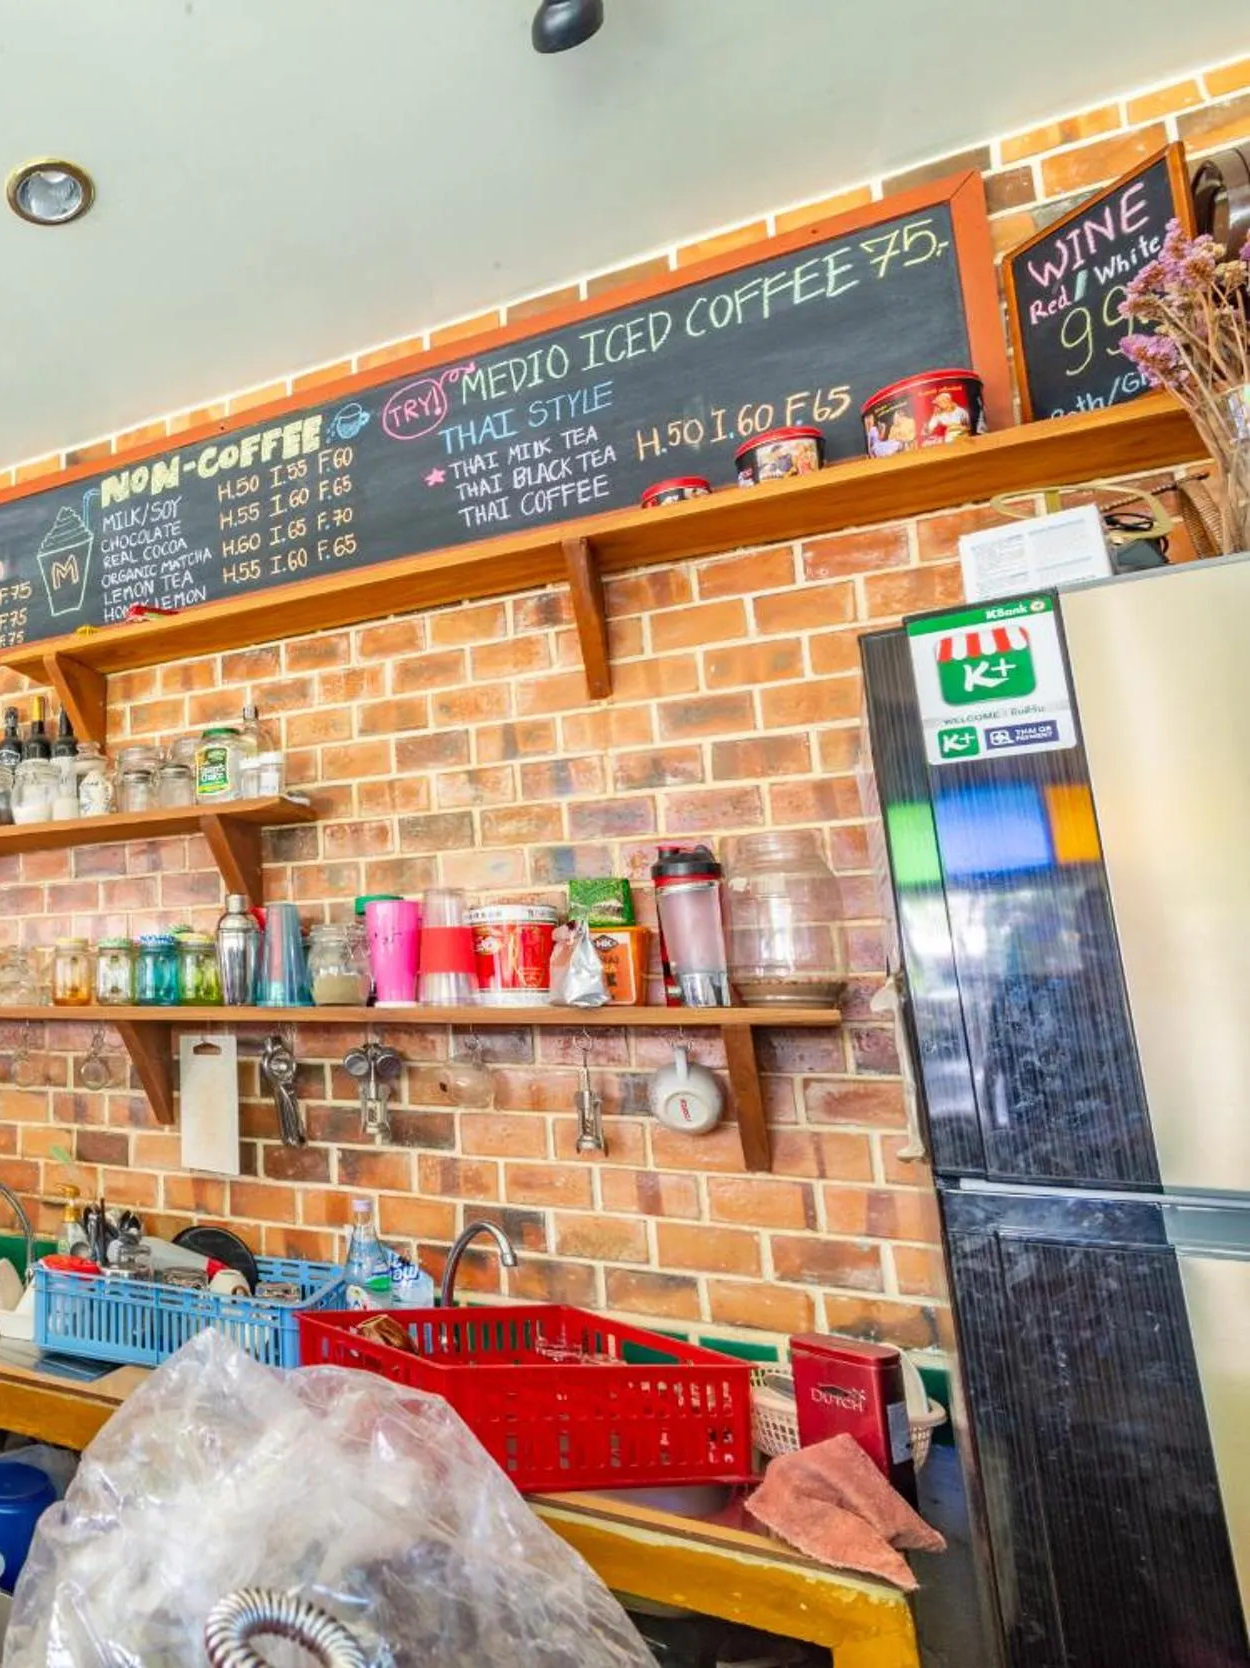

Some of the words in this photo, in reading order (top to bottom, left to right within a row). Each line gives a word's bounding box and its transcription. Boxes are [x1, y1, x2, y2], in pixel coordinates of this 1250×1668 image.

[1027, 181, 1150, 288] WINE
[462, 344, 569, 405] MEDIO
[579, 311, 672, 372] ICED
[686, 247, 860, 337] COFFEE
[389, 386, 442, 428] TRY!
[438, 408, 519, 454] THAI
[528, 380, 614, 428] STYLE
[448, 451, 500, 480] THAI
[507, 437, 553, 465] MILK
[560, 425, 599, 450] TEA
[455, 472, 503, 500] THAI
[513, 456, 573, 489] BLACK
[575, 445, 617, 472] TEA
[103, 496, 183, 532] MILK/SOY
[458, 496, 511, 528] THAI
[521, 474, 610, 516] COFFEE
[101, 520, 182, 553] CHOCOLATE
[103, 550, 138, 569] REAL
[143, 538, 188, 561] COCOA
[51, 553, 80, 591] M
[101, 564, 157, 588] ORGANIC
[161, 548, 212, 573] MATCHA
[104, 580, 155, 606] LEMON
[160, 570, 194, 592] TEA
[985, 601, 1028, 620] KBank
